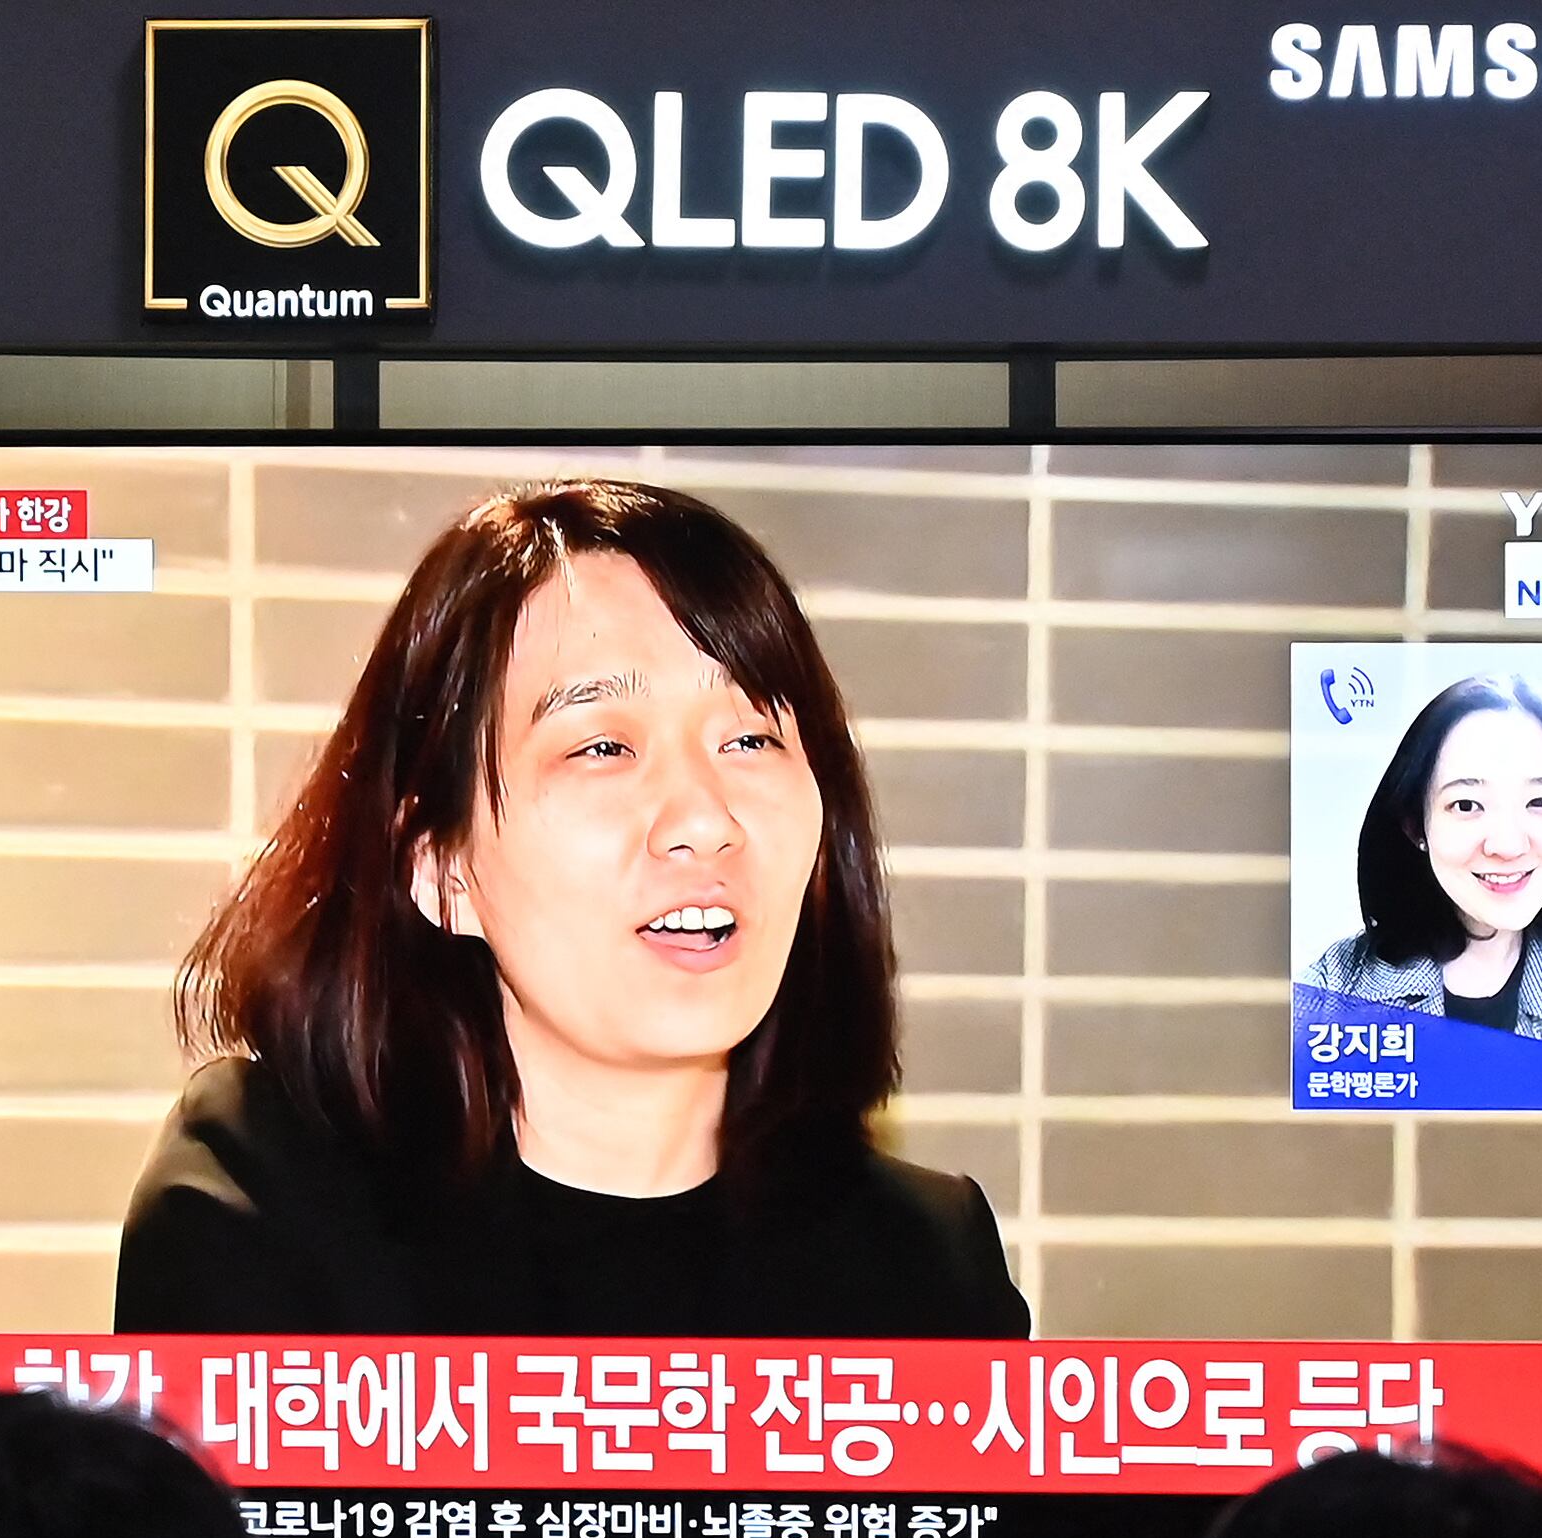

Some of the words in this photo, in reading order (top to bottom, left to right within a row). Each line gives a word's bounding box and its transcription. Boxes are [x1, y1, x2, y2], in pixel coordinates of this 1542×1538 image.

[204, 79, 381, 248] Q
[480, 88, 950, 248] QLED
[990, 90, 1211, 251] 8K
[199, 283, 373, 317] Quantum
[16, 497, 72, 533] 한강
[39, 547, 114, 583] 직시"
[1350, 699, 1375, 708] YTN
[1307, 1023, 1415, 1063] 강지희
[1307, 1071, 1419, 1098] 문학평론가
[200, 1350, 490, 1472] 대학에서
[508, 1352, 736, 1474] 국문학
[1289, 1358, 1445, 1470] 등단
